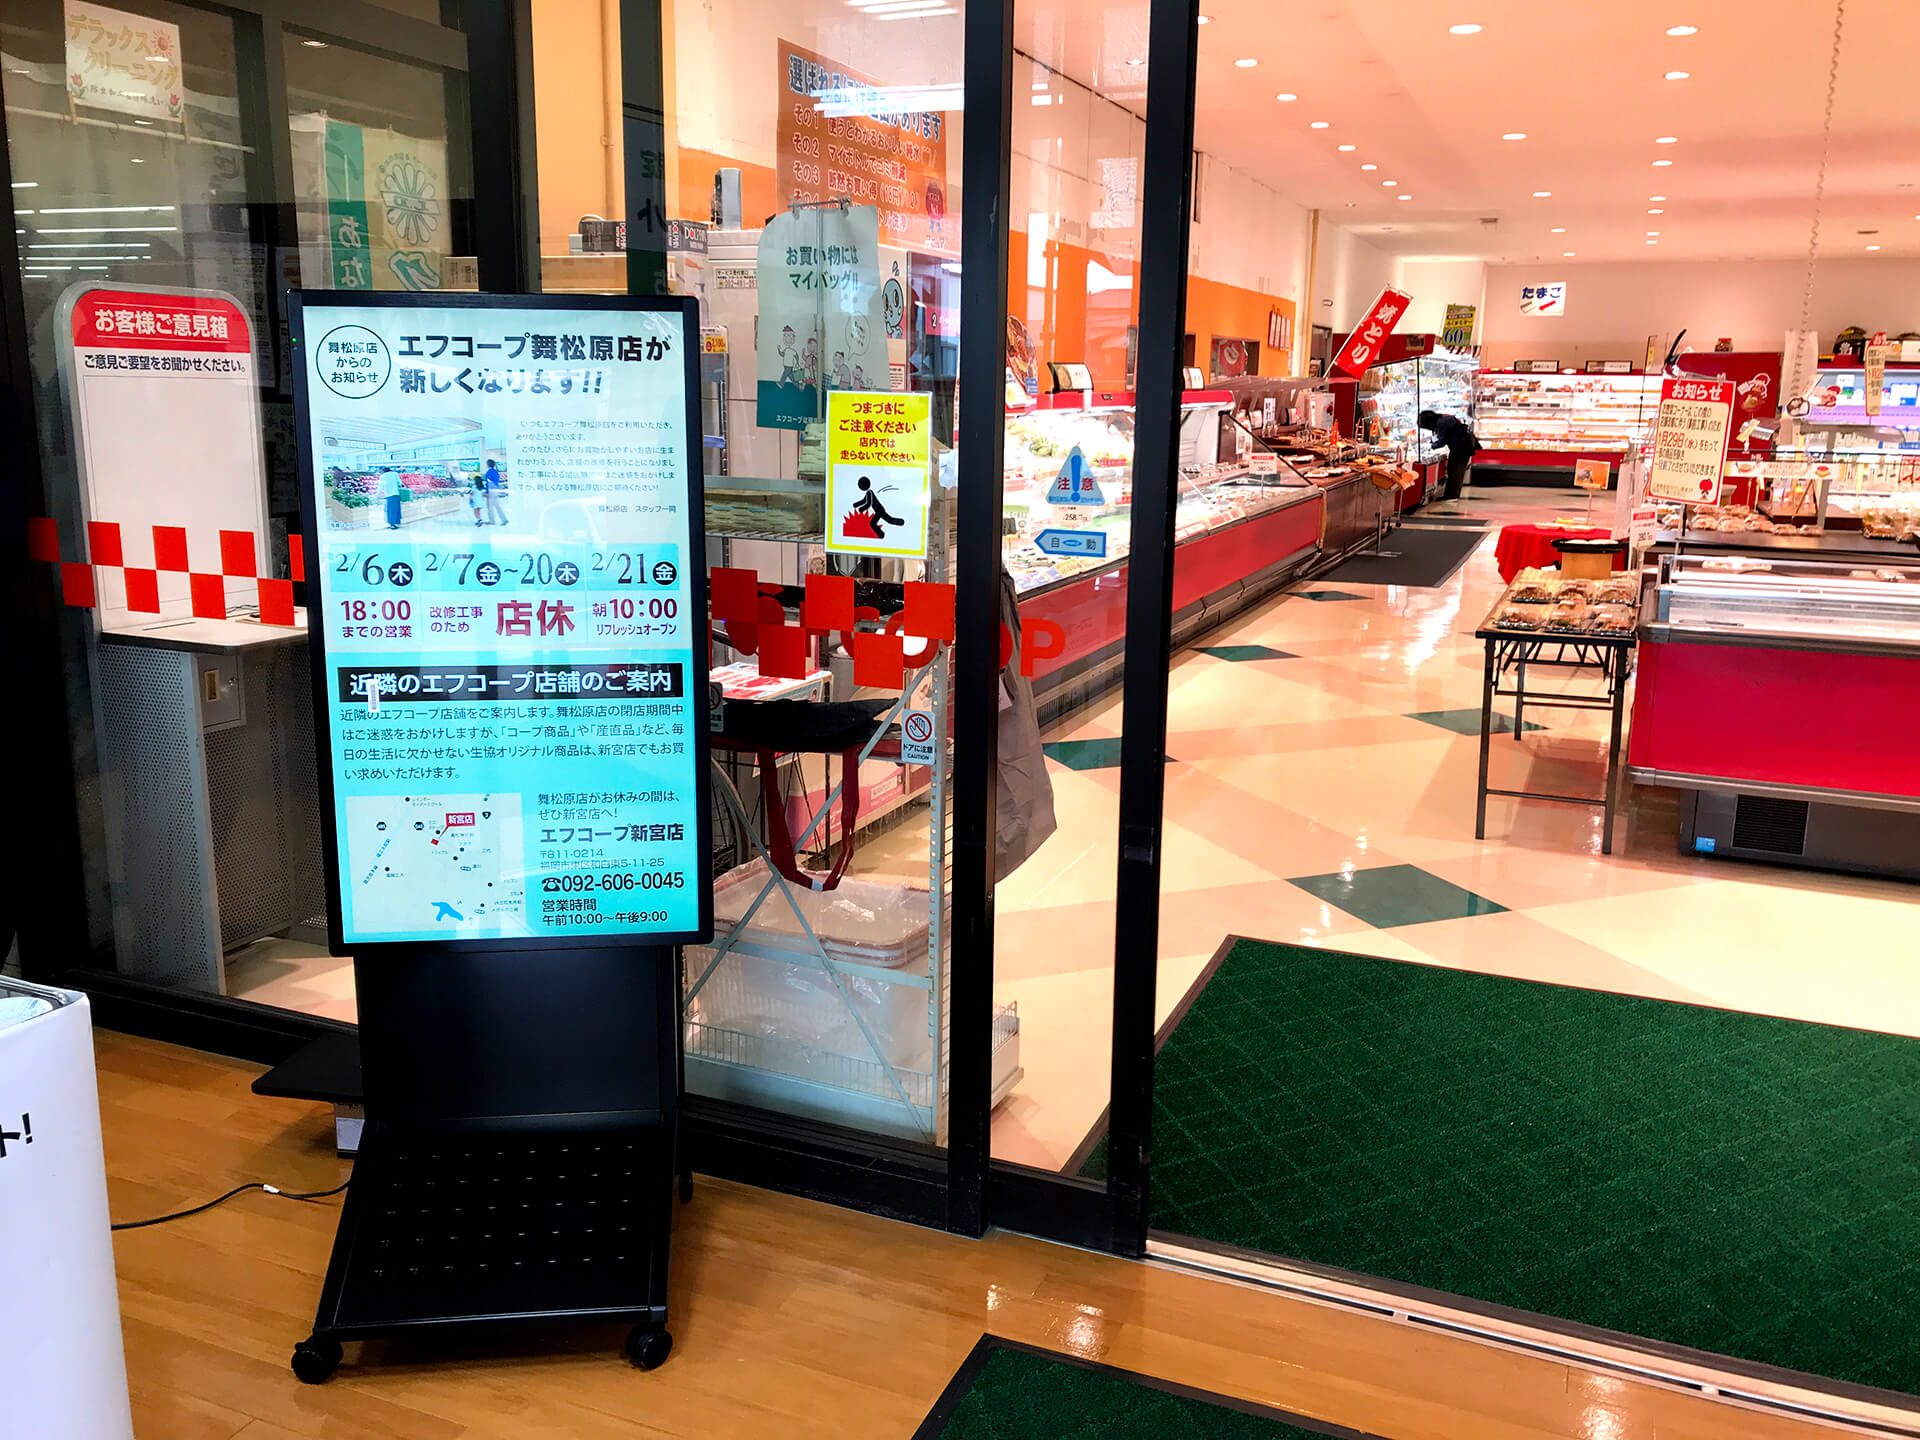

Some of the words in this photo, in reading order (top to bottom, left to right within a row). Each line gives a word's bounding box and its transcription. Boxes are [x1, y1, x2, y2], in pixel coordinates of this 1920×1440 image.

[68, 14, 152, 56] デラックス
[83, 46, 179, 90] クリーニング
[793, 104, 819, 130] その1
[792, 132, 820, 159] その2
[792, 161, 820, 184] その3
[786, 246, 859, 267] お買い物には
[1521, 286, 1563, 300] たまご
[95, 309, 229, 339] お客様ご意見箱
[1351, 302, 1399, 366] 焼とり
[328, 341, 378, 355] 舞松原店
[398, 332, 672, 362] エフコープ舞松原店が
[84, 354, 247, 373] ご意見ご要望をお聞かせください。
[336, 356, 372, 368] からの
[331, 371, 379, 384] お知らせ
[399, 367, 603, 395] 新しくなります!!
[1671, 382, 1723, 400] お知らせ
[851, 402, 905, 416] つまづきに
[839, 419, 917, 434] ご注意ください
[859, 437, 896, 448] 店内では
[840, 449, 916, 463] 走らないでください
[340, 600, 412, 622] 18:00
[495, 599, 576, 637] 店休
[429, 605, 484, 619] 改修工事
[342, 625, 413, 638] までの営業
[596, 623, 678, 637] リフレッシュオープン
[431, 621, 470, 633] のため
[350, 669, 673, 697] 近隣のエフコープ店舗のご案内
[343, 742, 685, 762] 日の生活に欠かせない生協オリジナル商品は、新宮店でもお買
[903, 743, 934, 754] ドアに注意
[906, 753, 931, 762] CAUTION
[344, 766, 460, 781] い求めいただけます。
[538, 790, 681, 806] 舞松原店がお休みの間は、
[538, 808, 618, 821] ぜひ新宮店へ!
[540, 823, 685, 843] エフコープ新宮店
[542, 898, 597, 913] 営業時間
